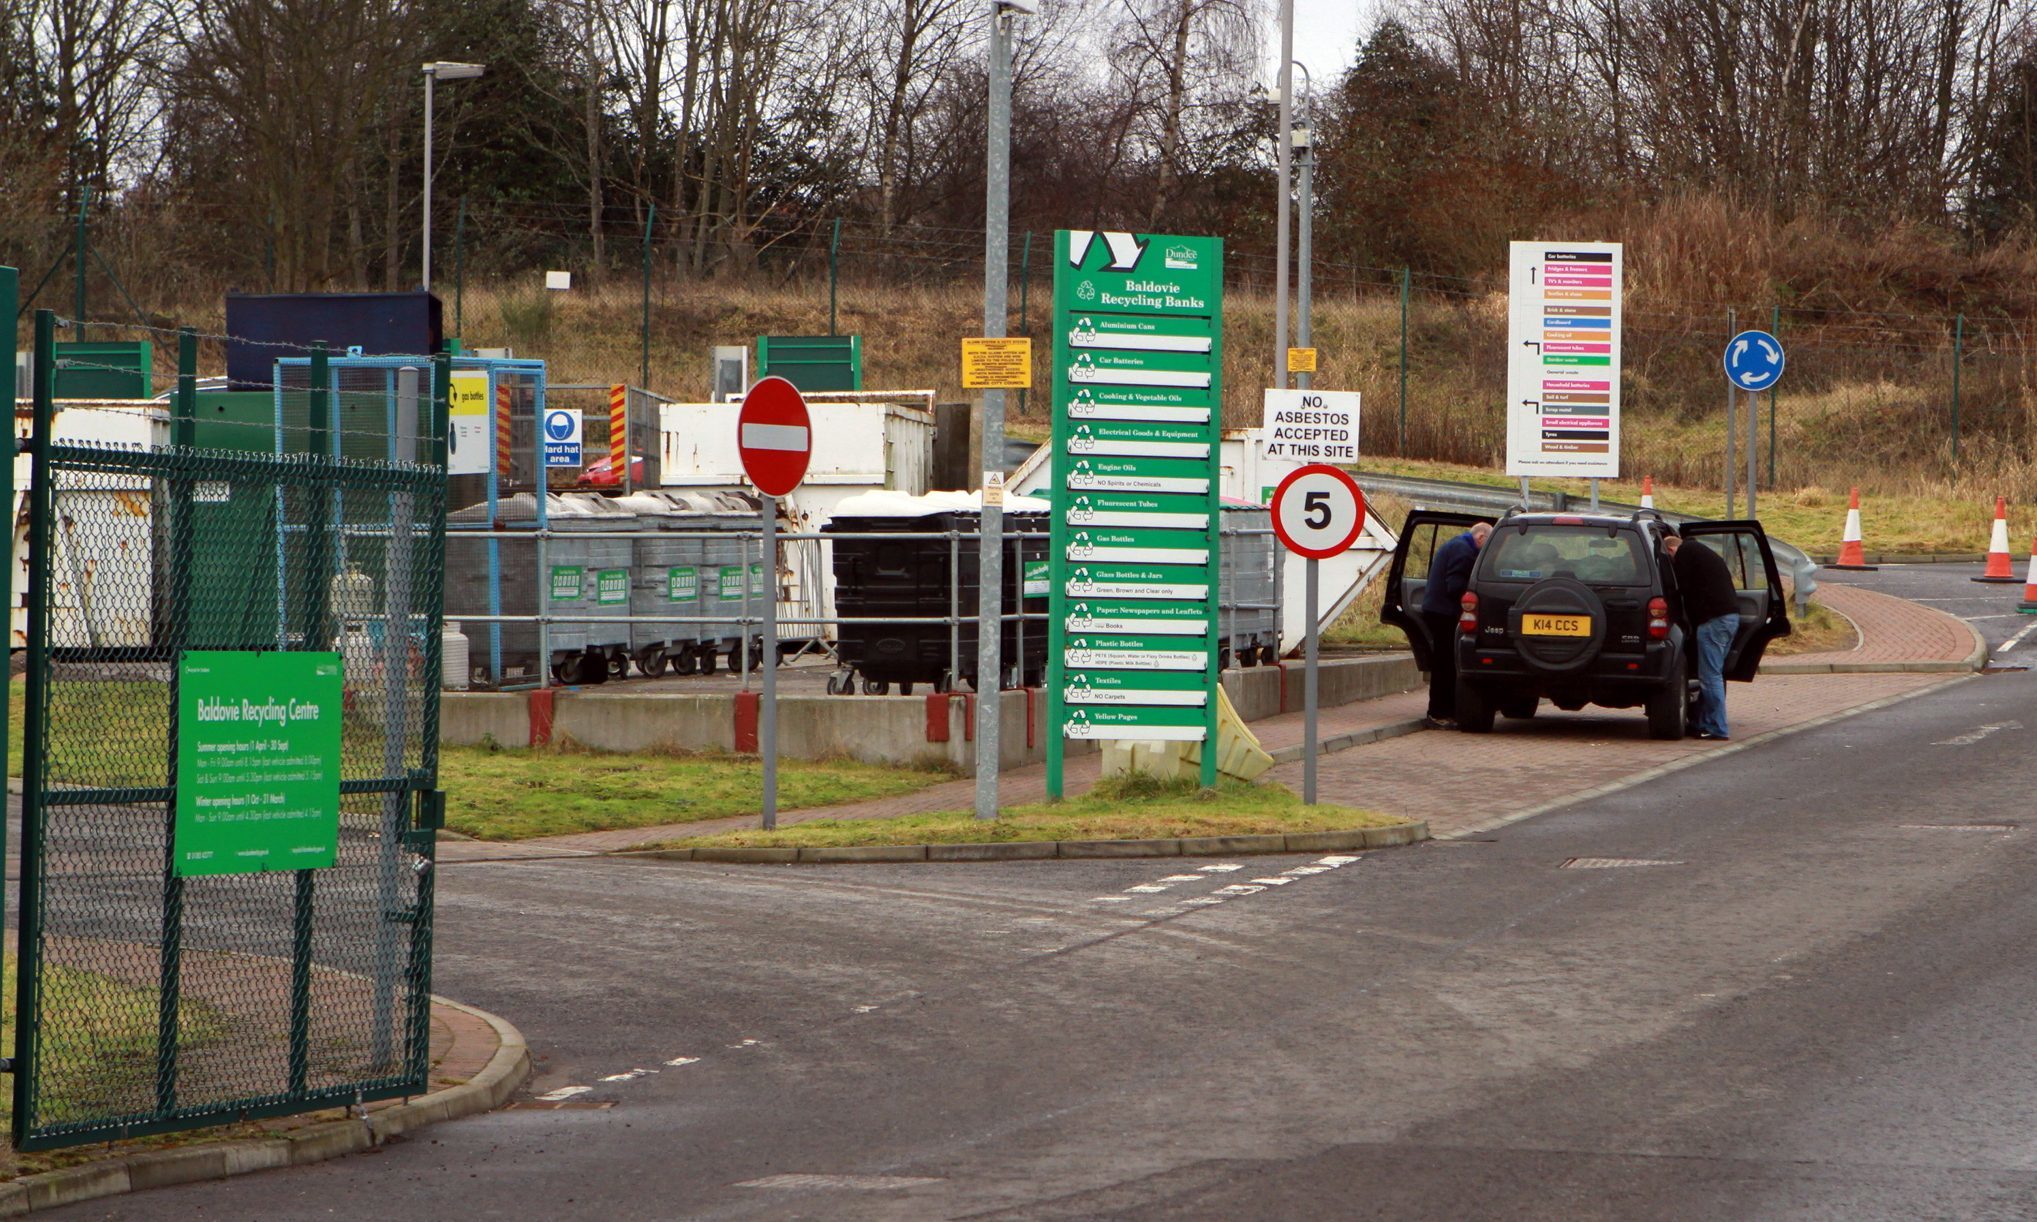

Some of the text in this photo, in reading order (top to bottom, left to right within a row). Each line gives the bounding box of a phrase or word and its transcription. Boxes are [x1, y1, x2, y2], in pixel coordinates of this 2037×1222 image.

[1166, 248, 1197, 258] Dundee
[1126, 280, 1180, 293] Baldovie
[1101, 293, 1204, 308] Recycling Banks
[1100, 322, 1136, 330] Aluminium
[470, 392, 484, 400] bottles
[1099, 392, 1126, 400] Cooking
[1136, 394, 1166, 402] Vegetable
[1275, 412, 1349, 425] ASBESTOS
[1162, 430, 1198, 438] Equipment
[1274, 428, 1348, 441] ACCEPTED
[565, 445, 578, 453] hat
[1268, 444, 1354, 458] AT THIS SITE
[1304, 492, 1332, 530] 5
[1120, 607, 1160, 615] Newspapers
[1485, 626, 1504, 634] Jeep
[1534, 619, 1578, 631] K14 CCS
[198, 696, 318, 728] Baldovie Recycling Centre
